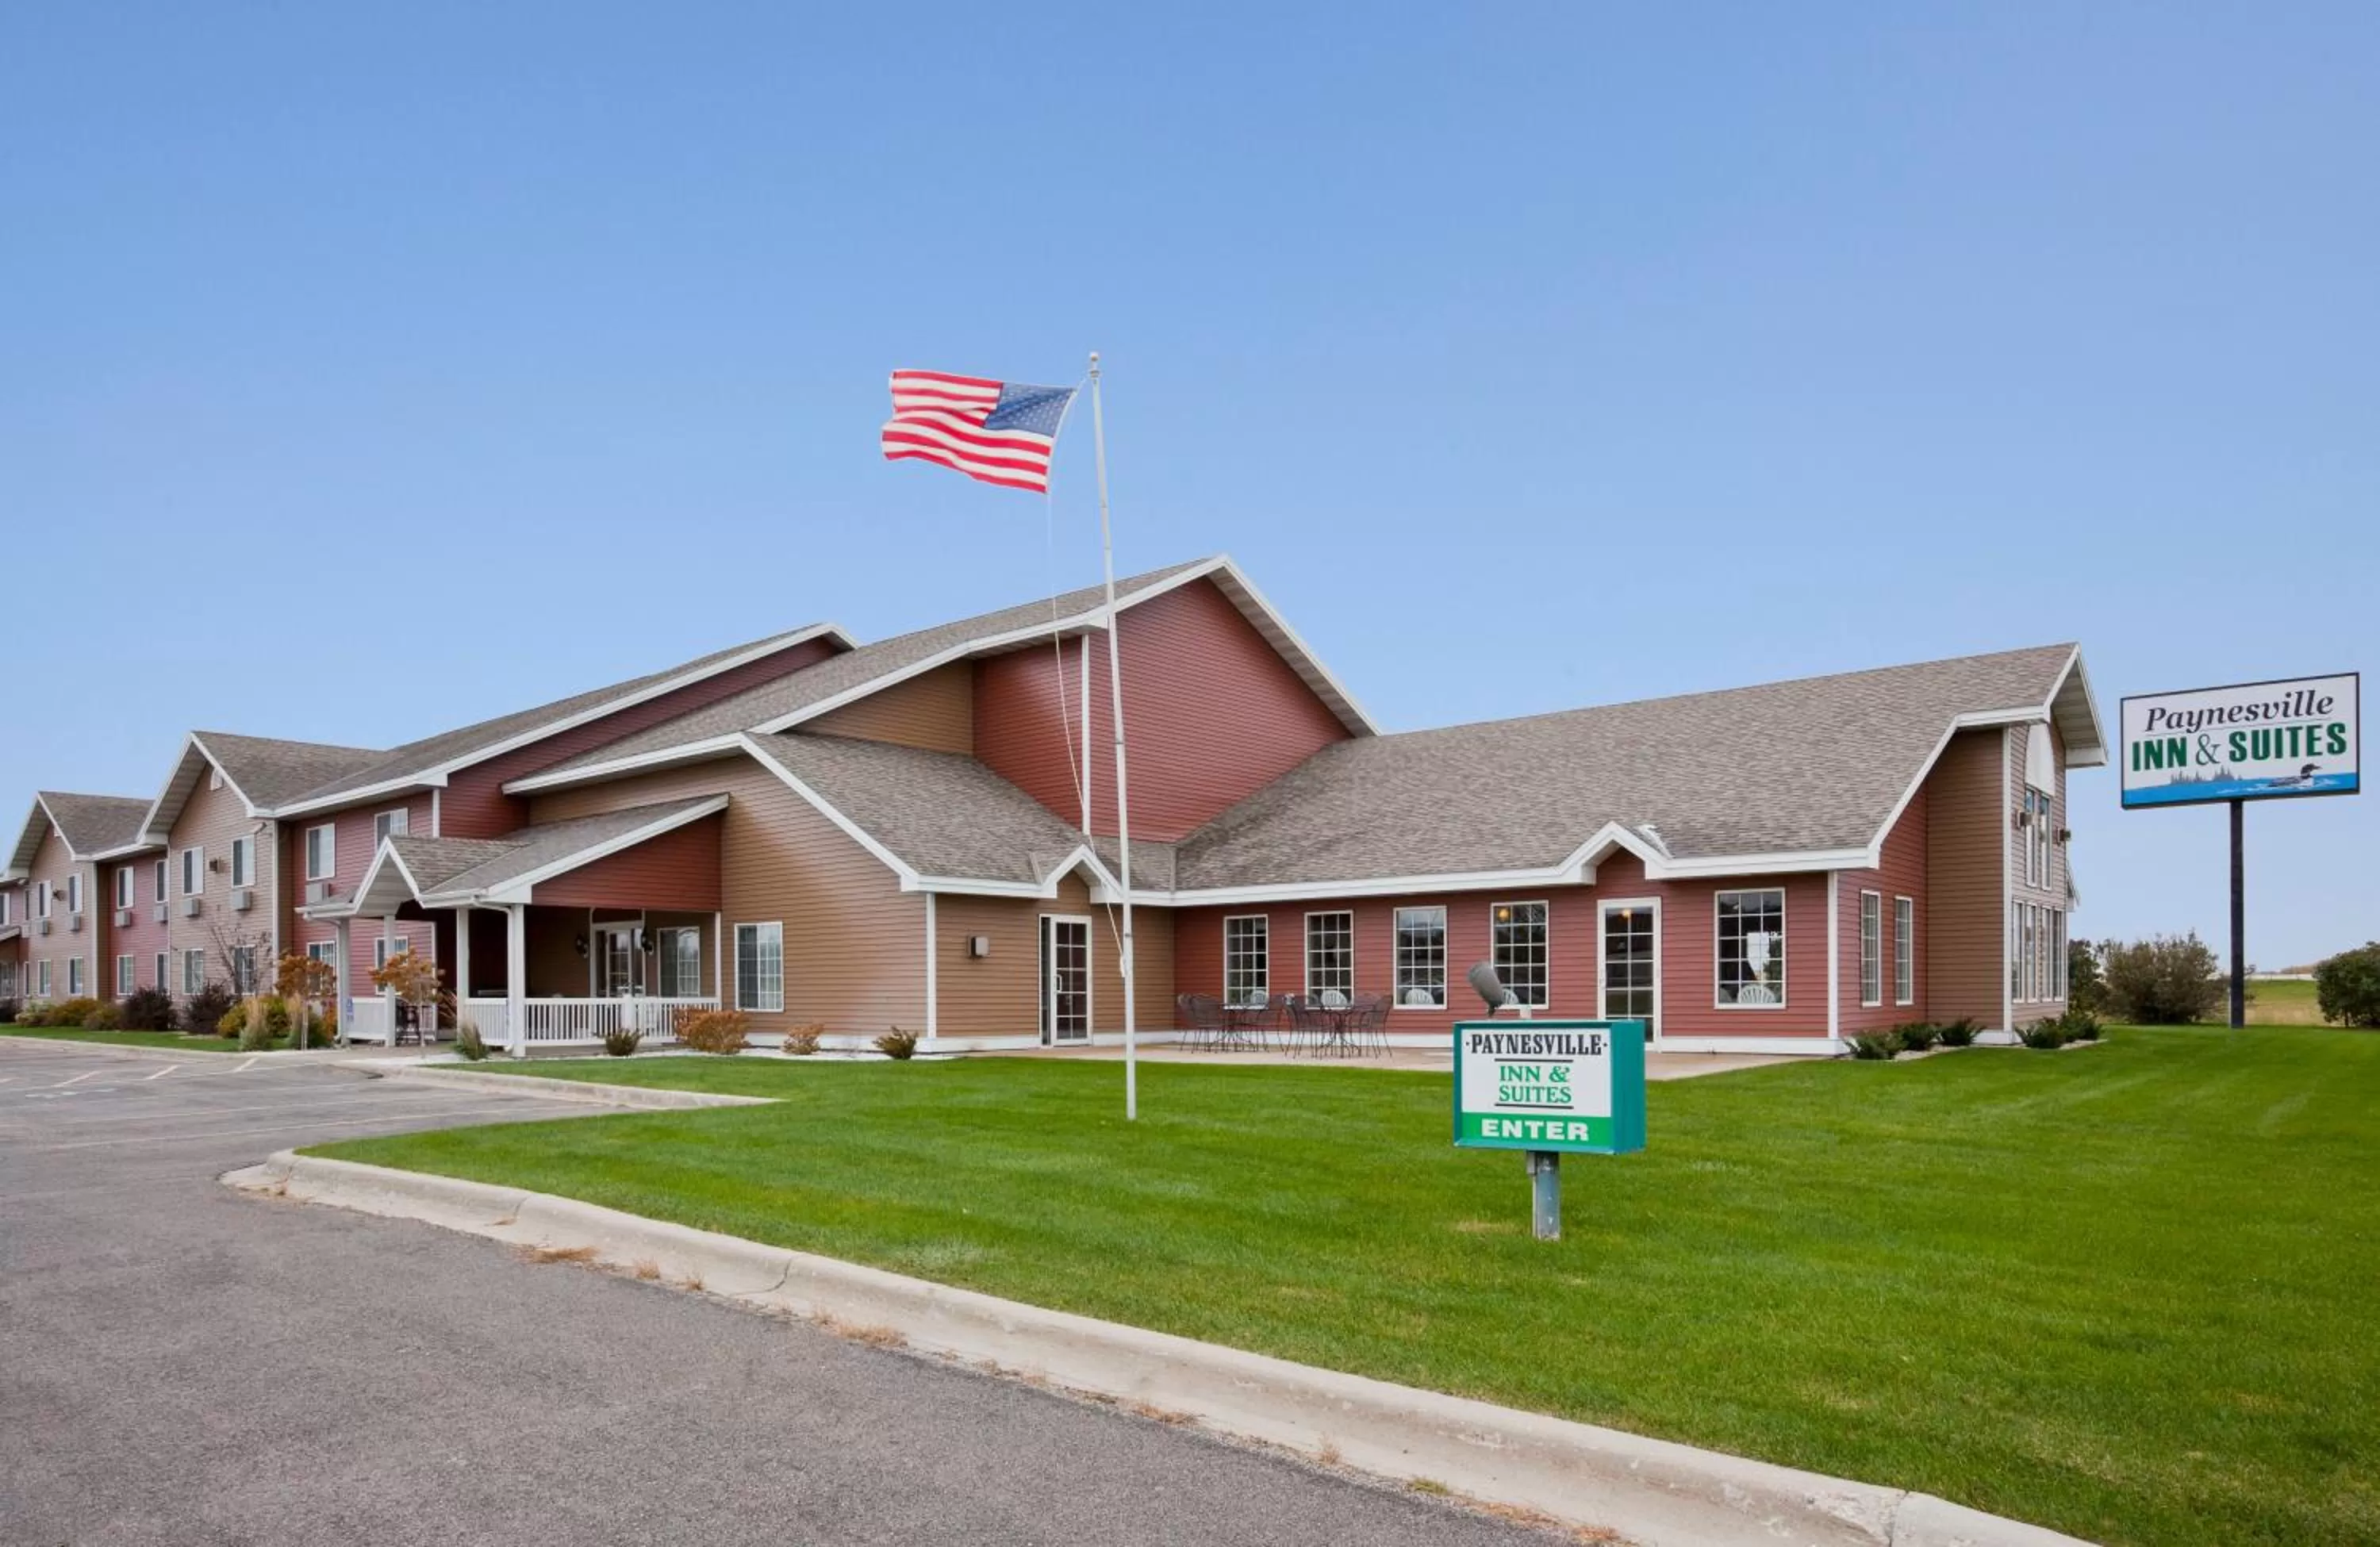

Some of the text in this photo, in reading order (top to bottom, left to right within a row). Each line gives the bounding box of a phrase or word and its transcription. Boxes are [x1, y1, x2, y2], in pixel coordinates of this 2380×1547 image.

[2145, 690, 2333, 733] Paynesville
[2132, 723, 2347, 771] INN & SUITES
[1471, 1034, 1603, 1055] PAYNESVILLE
[1499, 1065, 1570, 1083] INN &
[1499, 1085, 1572, 1104] SUITES
[1481, 1119, 1590, 1142] ENTER
